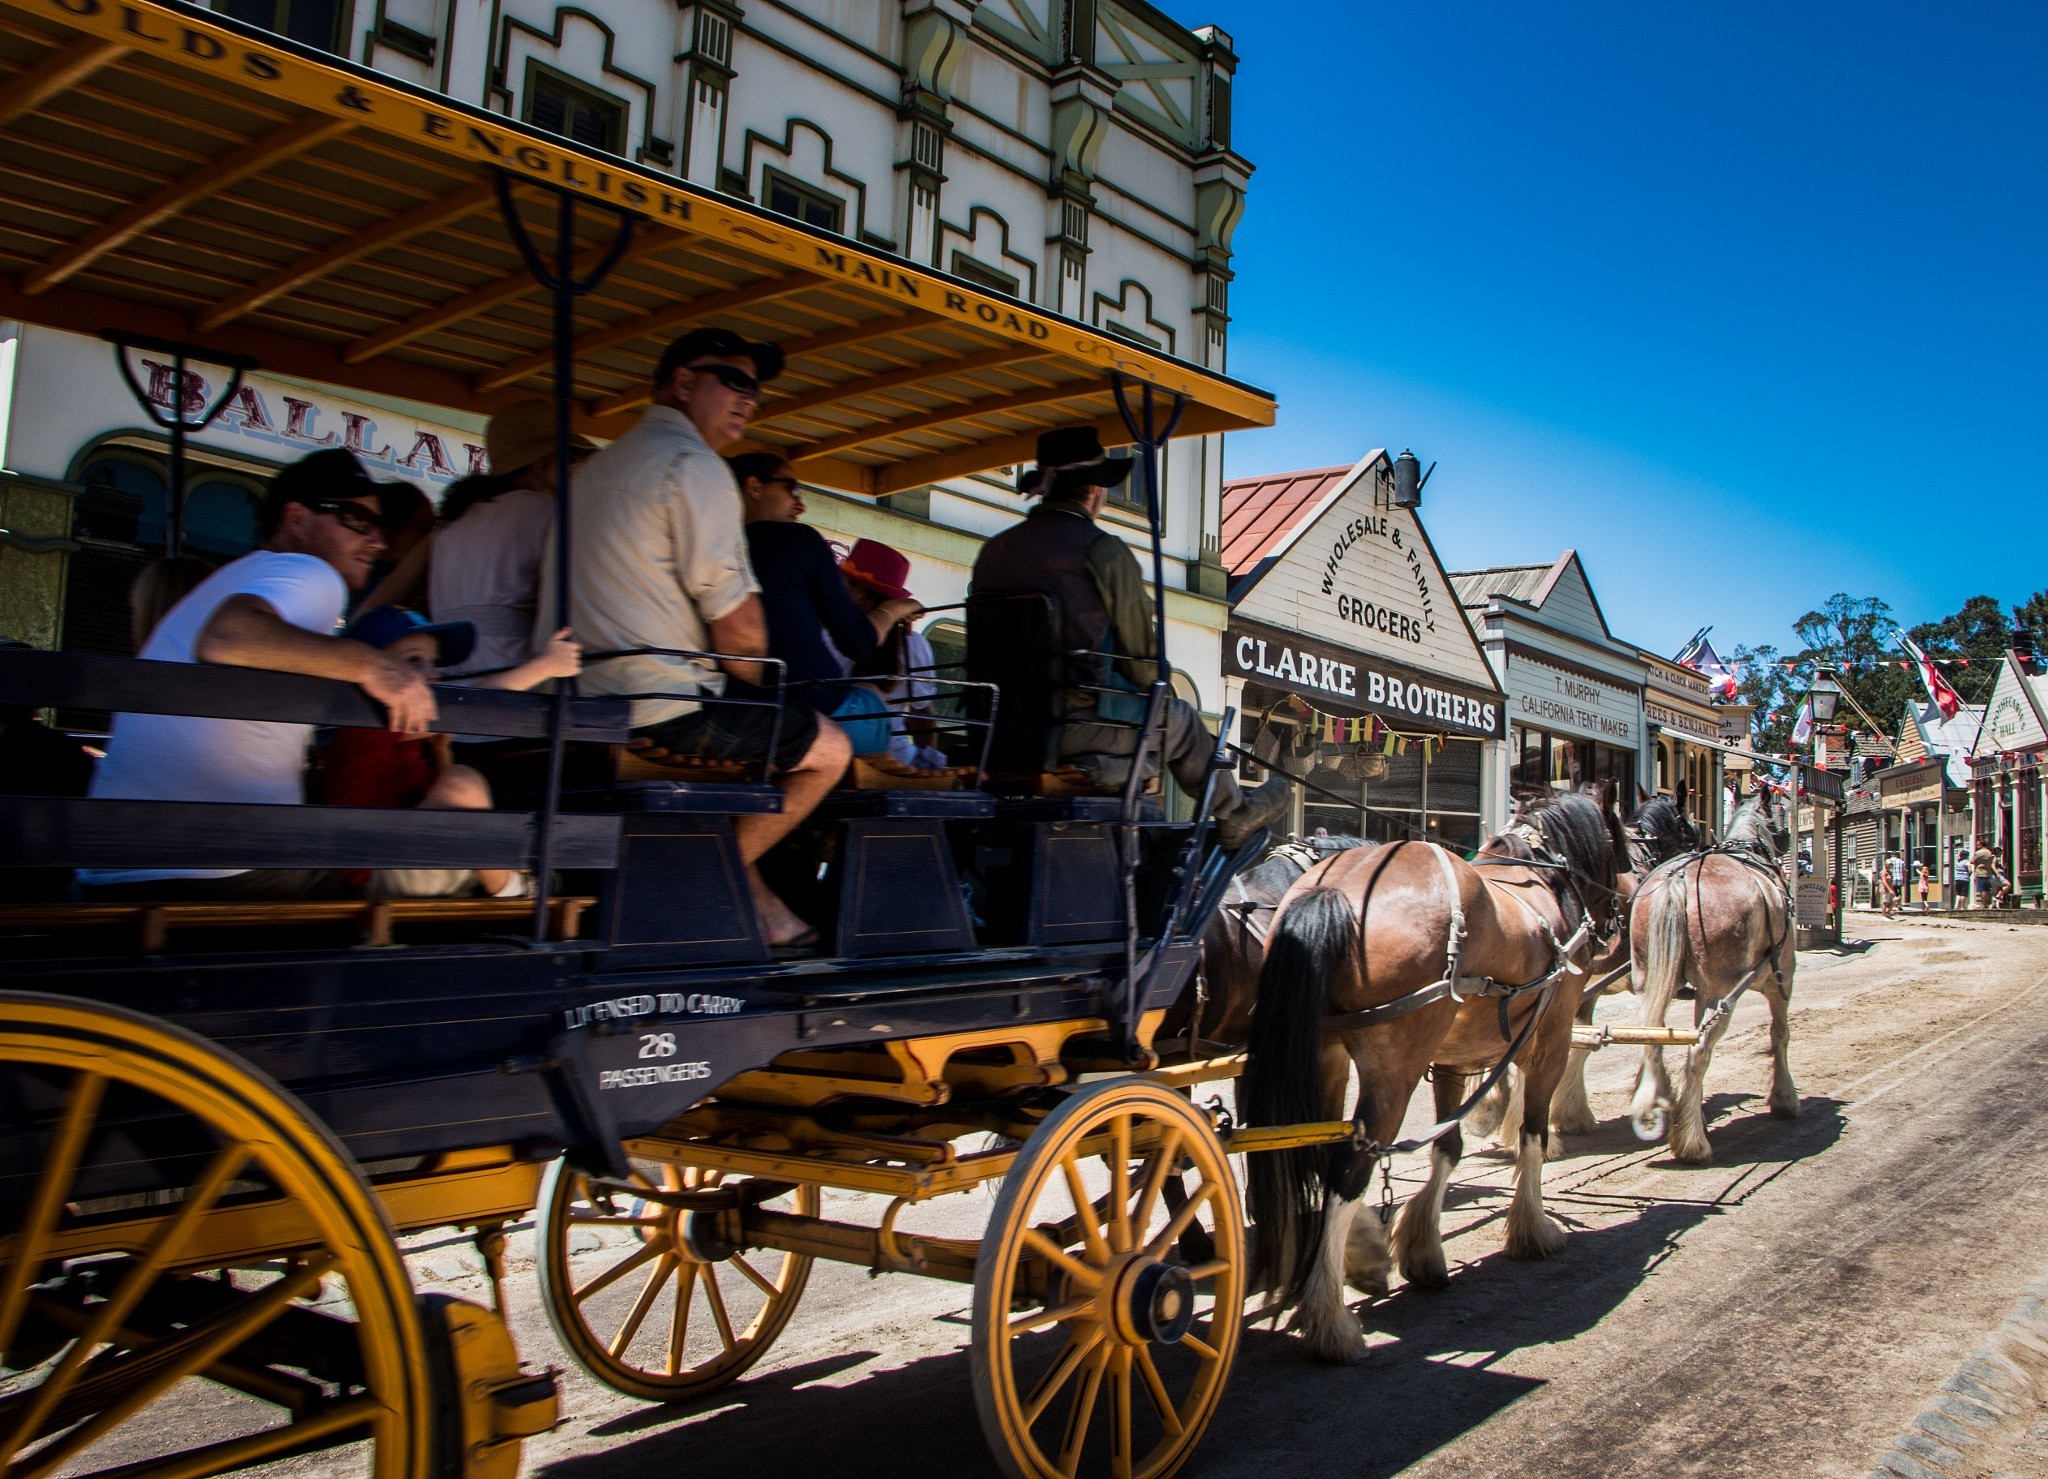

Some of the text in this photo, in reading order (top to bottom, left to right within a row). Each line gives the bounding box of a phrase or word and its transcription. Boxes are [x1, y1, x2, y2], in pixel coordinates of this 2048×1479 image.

[336, 85, 375, 114] &
[421, 109, 695, 222] ENGLISH
[815, 246, 921, 298] MAIN
[945, 290, 1049, 340] ROAD
[1321, 516, 1435, 634] WHOLESALE & FAMILY
[1338, 594, 1421, 644] GROCERS
[1236, 636, 1496, 732] CLARKE BROTHERS
[1555, 676, 1562, 694] T.
[1670, 673, 1687, 688] CLOCK
[1687, 678, 1708, 696] MAKERS
[1521, 695, 1629, 739] CALIFORNIA TENT MAKER
[1647, 704, 1717, 739] REES & BENJAMIN
[2000, 722, 2016, 738] HALL
[565, 993, 746, 1030] LICENSED TO CARRY
[638, 1032, 677, 1059] 28
[599, 1061, 712, 1091] PASSENGERS
